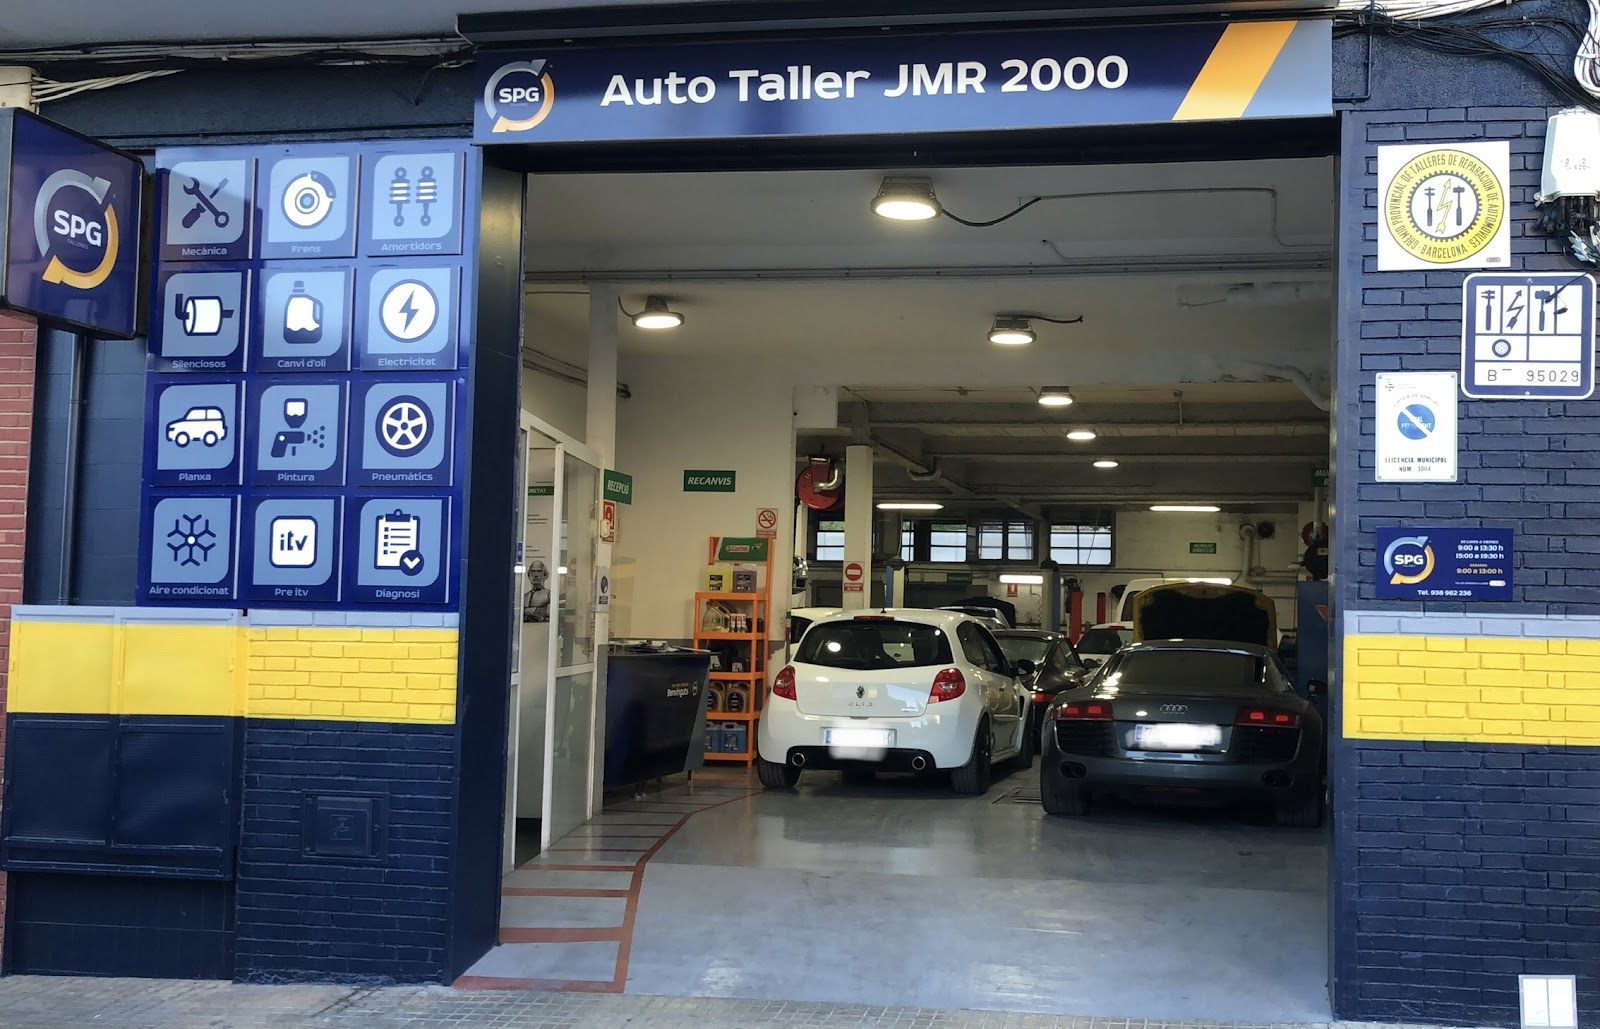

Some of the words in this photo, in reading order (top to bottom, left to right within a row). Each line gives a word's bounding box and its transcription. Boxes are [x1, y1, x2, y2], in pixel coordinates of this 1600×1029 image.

[600, 71, 716, 107] Auto
[728, 65, 871, 102] Taller
[883, 61, 987, 97] JMR
[1001, 55, 1129, 92] 2000
[499, 86, 539, 103] SPG
[1410, 154, 1446, 174] TALLERES
[1448, 154, 1458, 166] DE
[1400, 170, 1414, 182] DE
[1458, 156, 1496, 192] REPARACION
[1486, 192, 1499, 202] DE
[1390, 182, 1407, 226] PROVINCIAL
[54, 210, 102, 246] SPG
[1468, 204, 1499, 248] AUTOMOVILES
[1395, 225, 1420, 250] GREMIO
[292, 245, 321, 253] Frens
[381, 242, 442, 251] Amortidors
[1420, 244, 1468, 258] BARCELONA
[172, 360, 226, 368] Silenciosos
[277, 359, 305, 368] Canvi
[306, 358, 326, 367] d'oli
[378, 357, 436, 366] Electricitat
[1526, 370, 1579, 382] 95029
[277, 473, 315, 481] Pintura
[688, 477, 732, 485] RECANVIS
[607, 480, 630, 494] RECEPCIÓ
[280, 530, 308, 551] itv
[1394, 554, 1424, 565] SPG
[149, 586, 170, 594] Aire
[172, 586, 229, 595] condicionat
[275, 588, 293, 596] Pre
[294, 588, 309, 596] itv
[376, 588, 420, 600] Diagnosi
